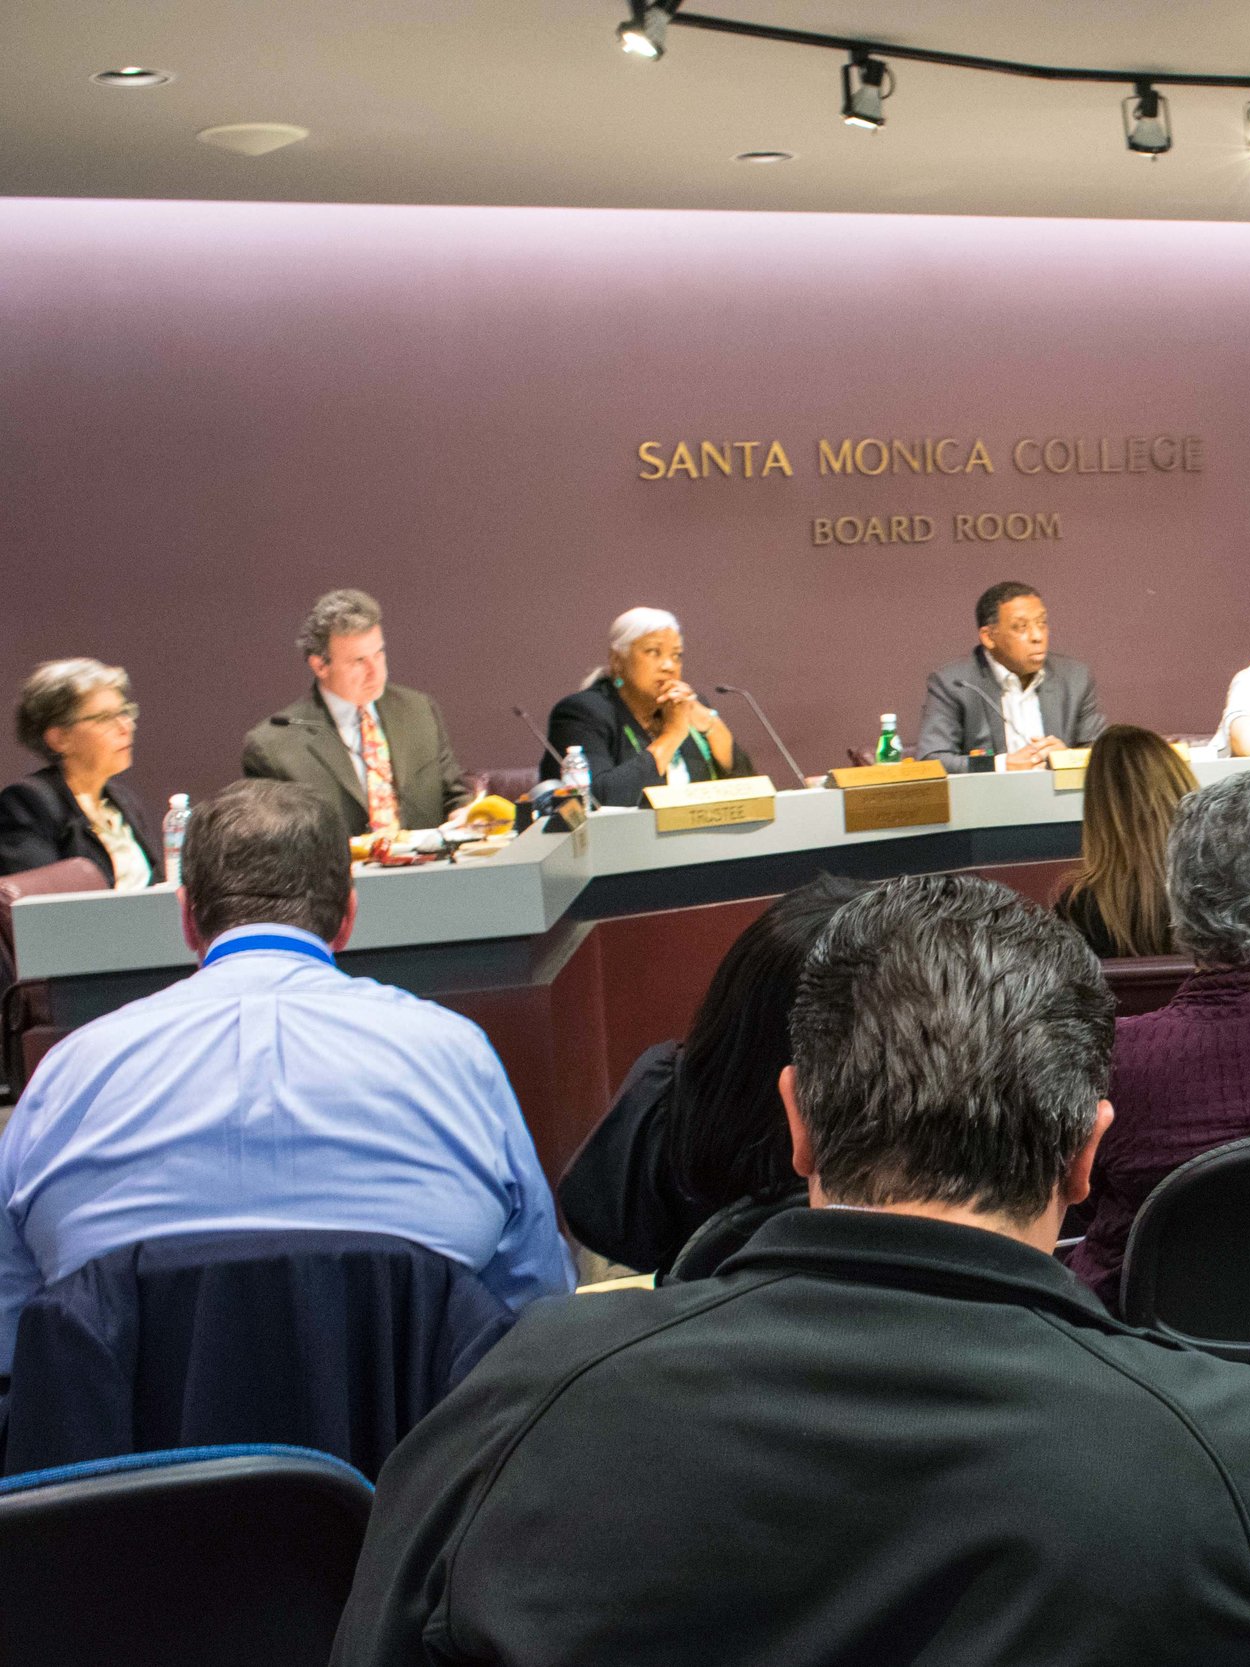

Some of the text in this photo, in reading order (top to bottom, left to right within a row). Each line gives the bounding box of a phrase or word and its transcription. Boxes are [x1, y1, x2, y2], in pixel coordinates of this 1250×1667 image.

[638, 436, 1204, 480] SANTA MONICA COLLEGE
[813, 512, 1063, 546] BOARD ROOM
[689, 804, 746, 824] TRUSTEE
